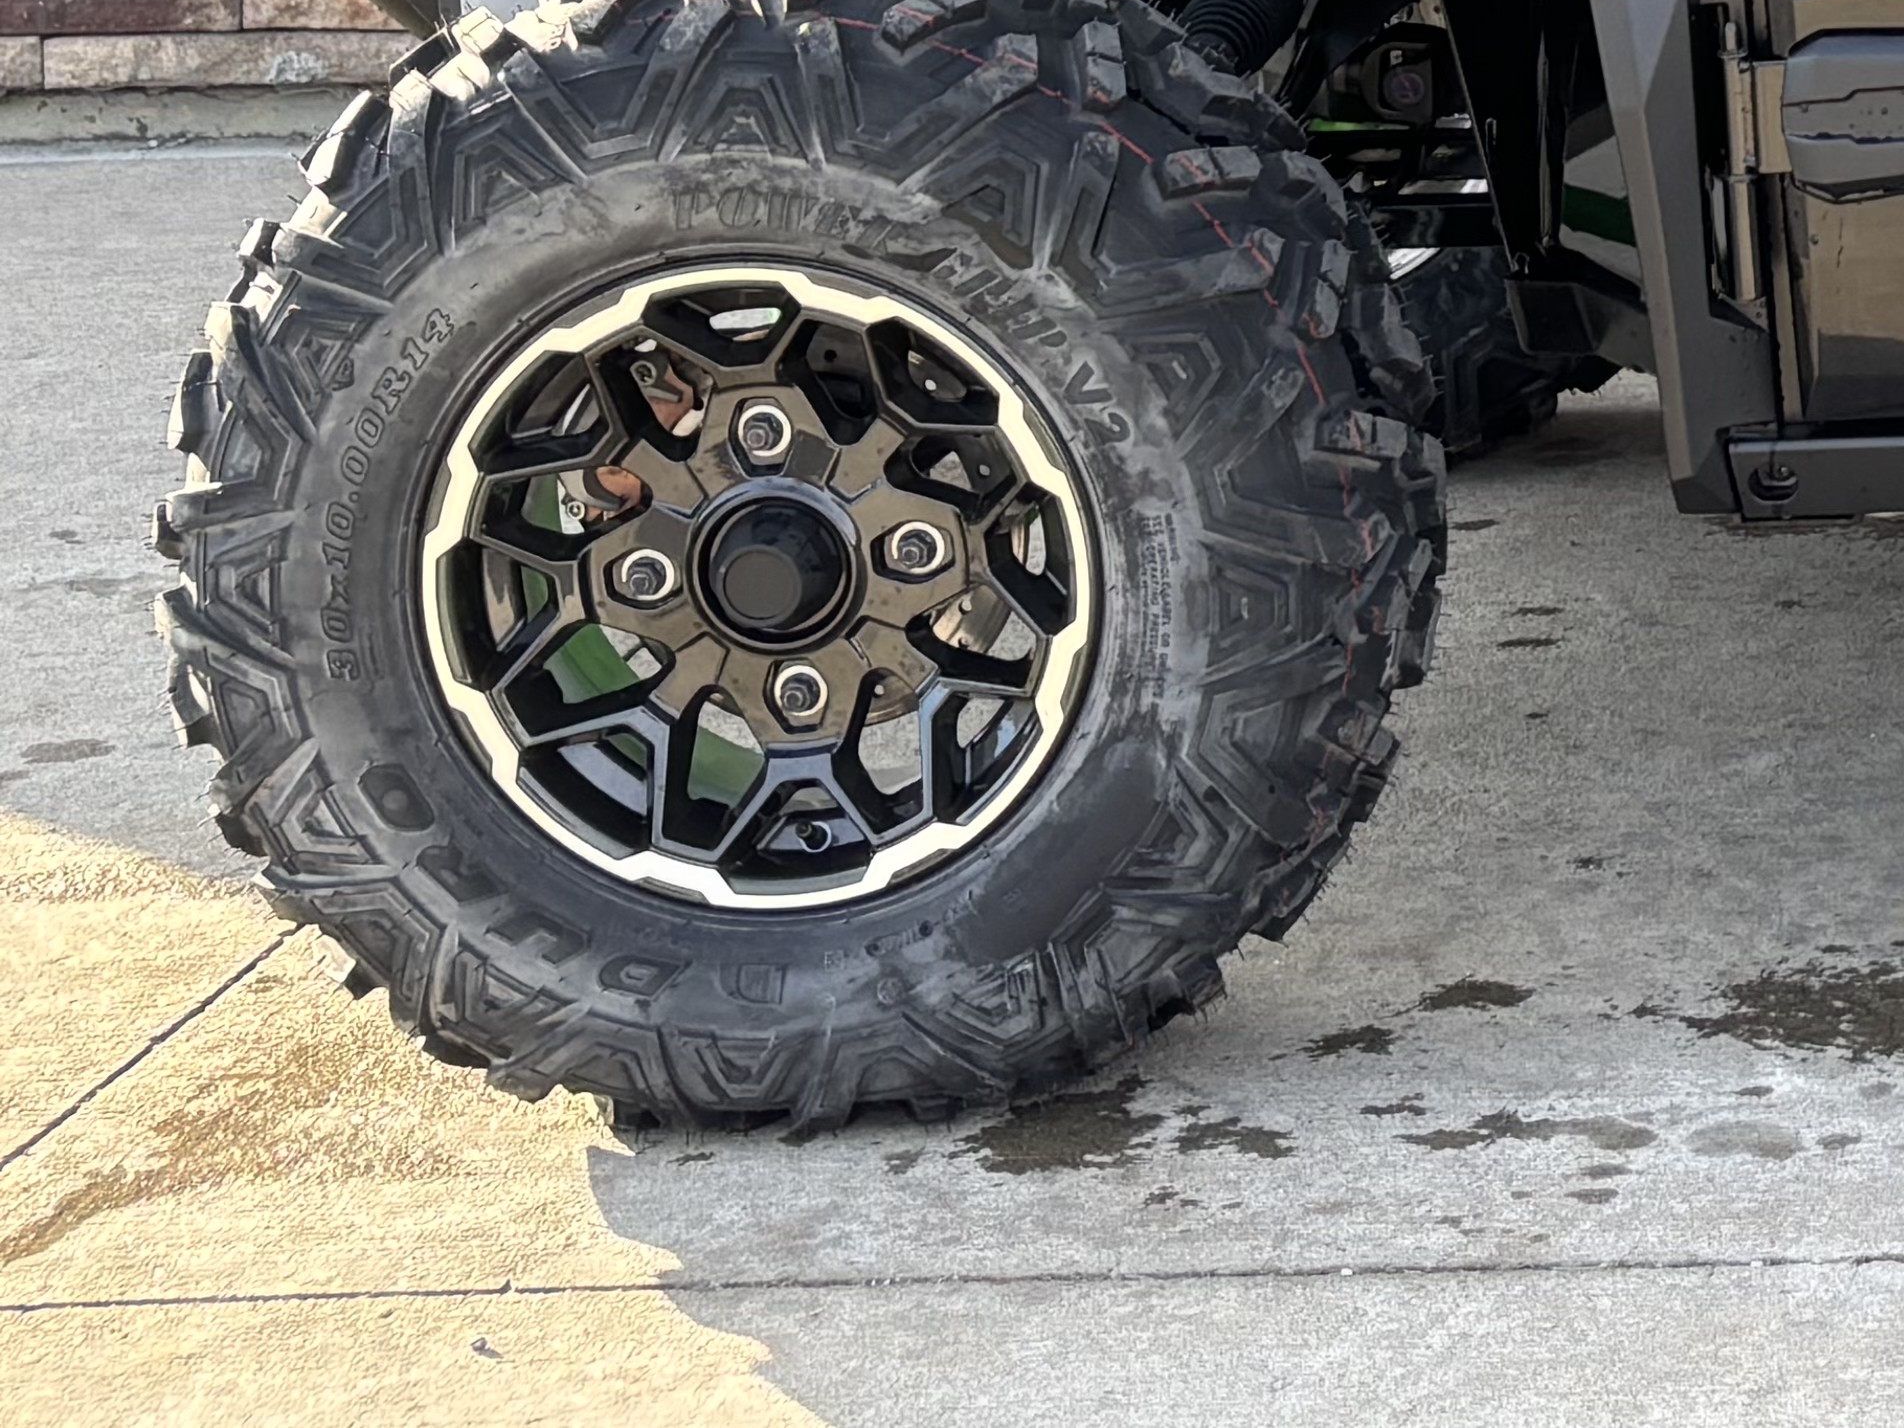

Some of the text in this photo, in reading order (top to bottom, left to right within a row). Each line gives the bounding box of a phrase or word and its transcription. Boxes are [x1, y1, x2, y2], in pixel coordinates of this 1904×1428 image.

[320, 307, 455, 682] 30x10.00R14
[1063, 361, 1130, 444] V2
[359, 763, 691, 997] DURO
